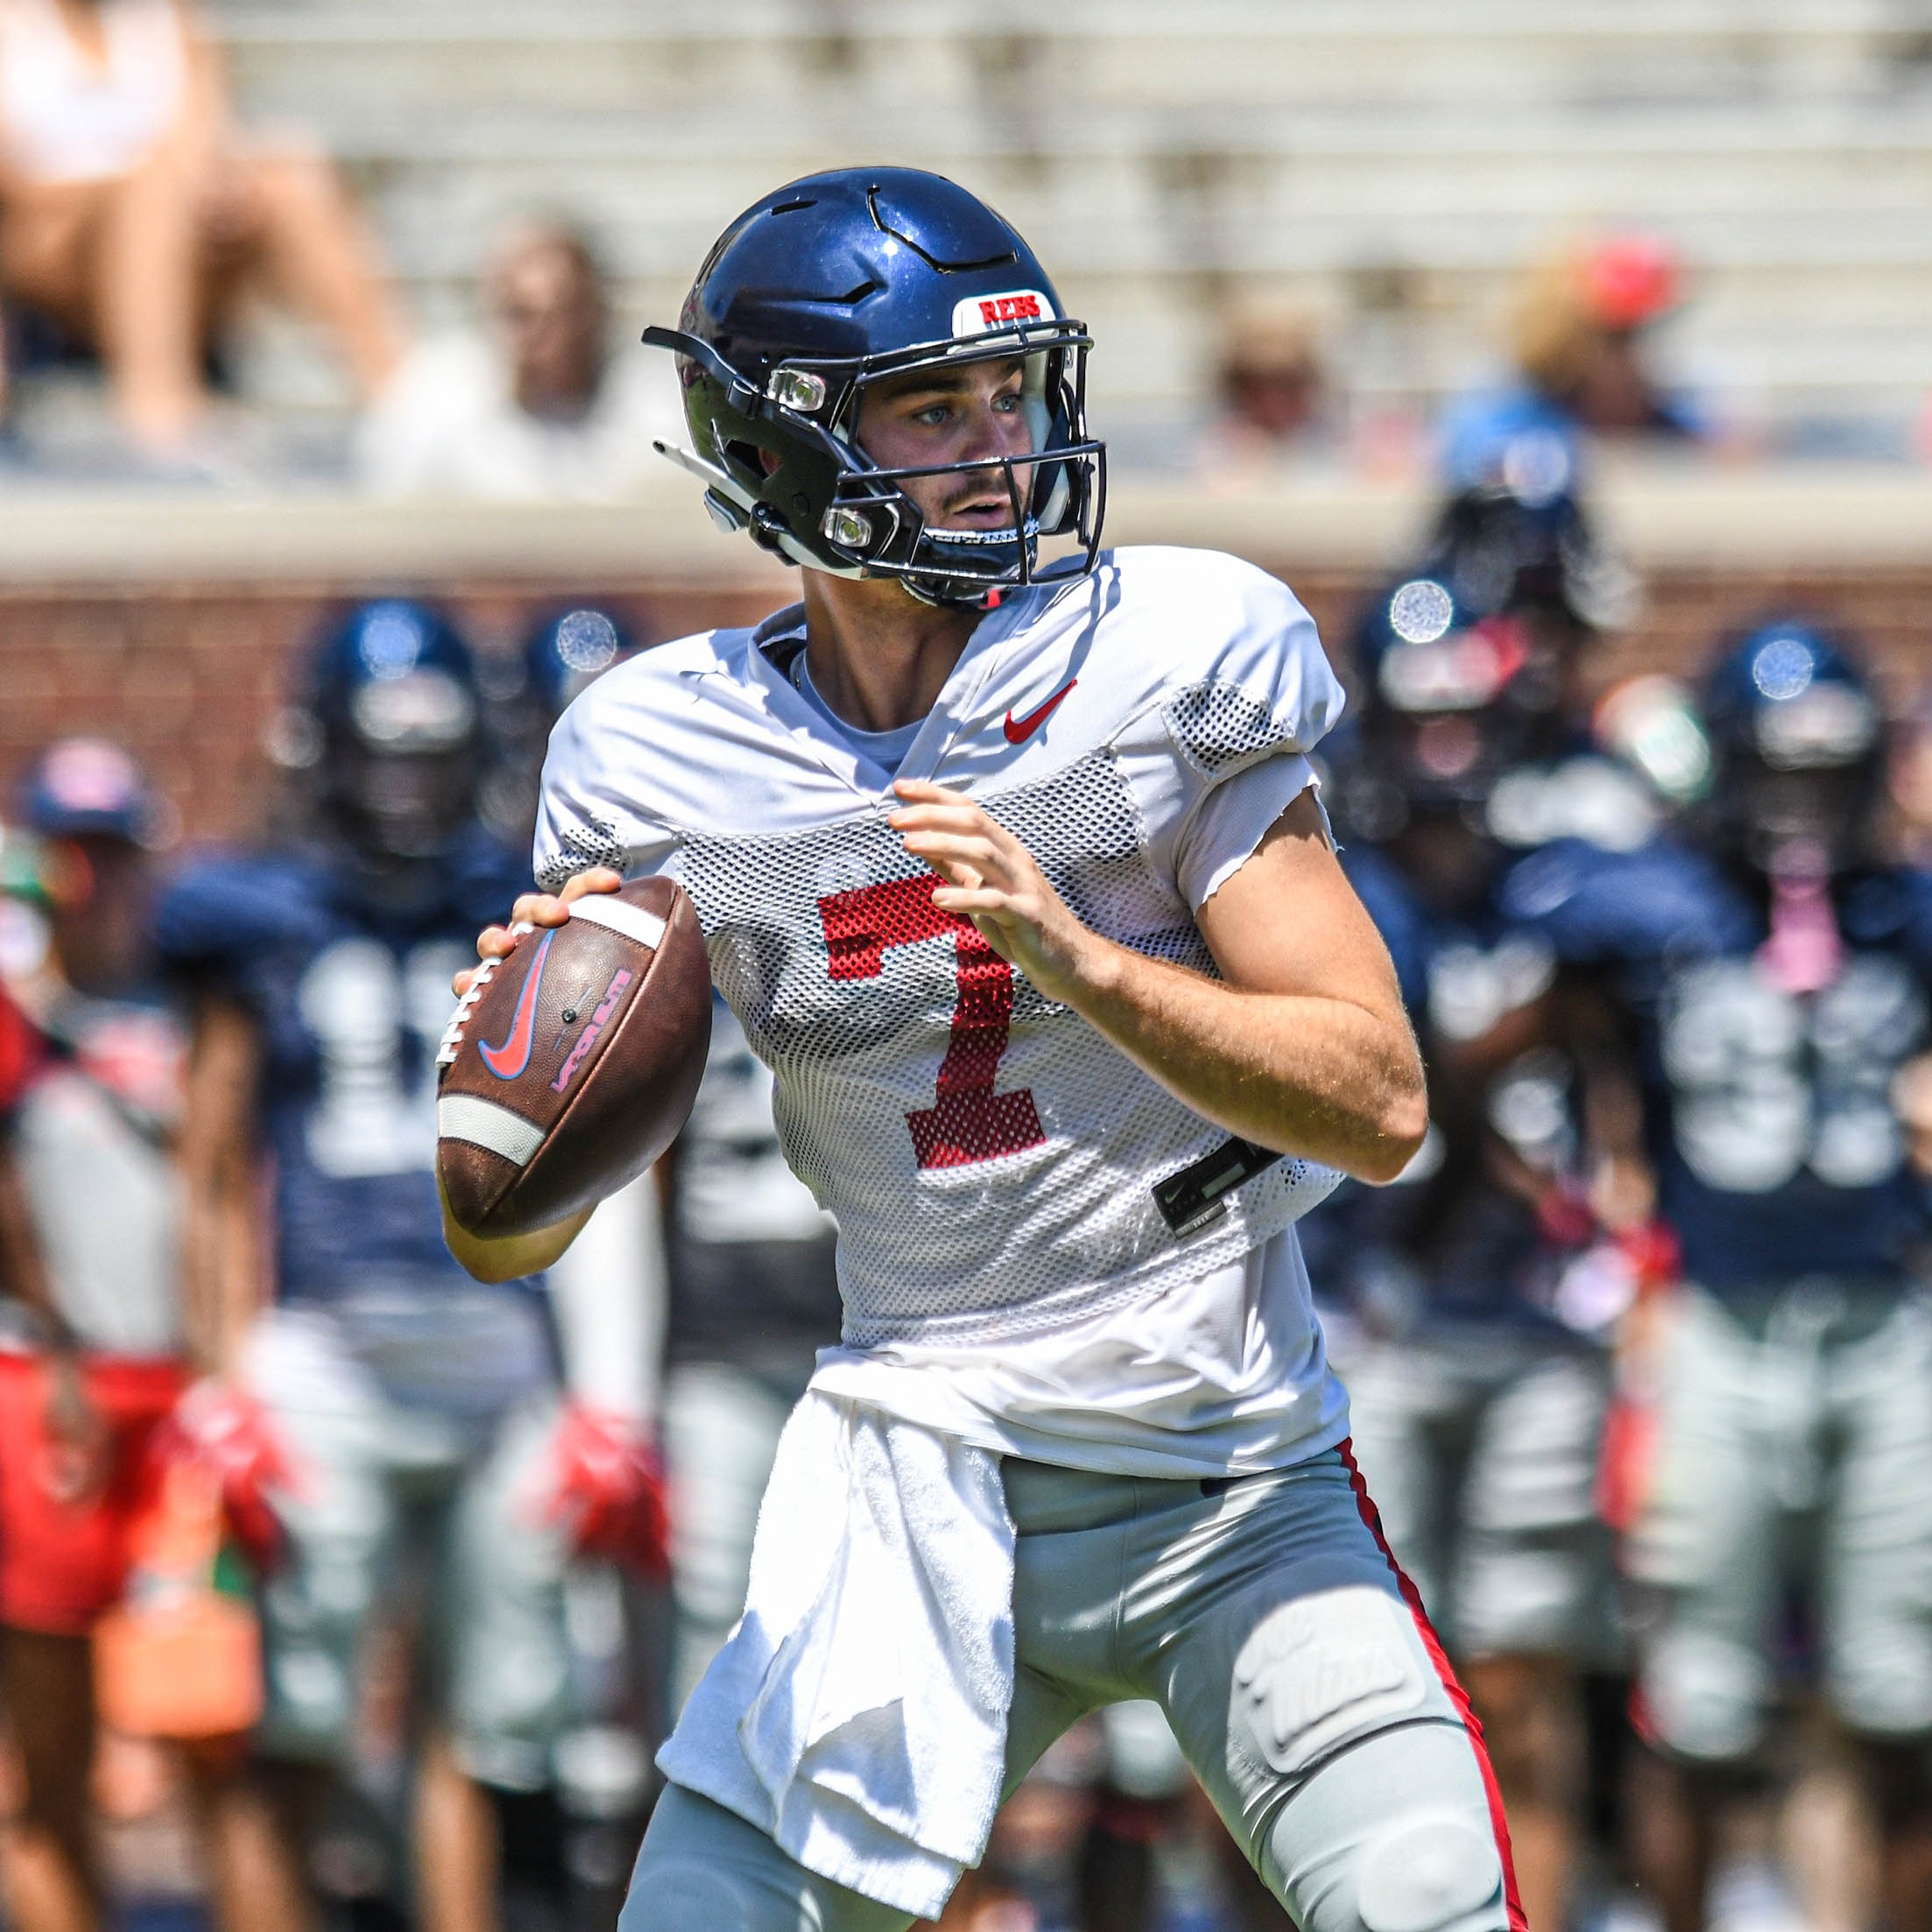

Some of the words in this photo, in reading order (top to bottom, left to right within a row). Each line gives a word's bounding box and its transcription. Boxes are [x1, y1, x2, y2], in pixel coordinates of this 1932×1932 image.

[551, 1022, 601, 1093] VAPOR
[592, 969, 632, 1026] ELITE
[817, 872, 1047, 1170] 7
